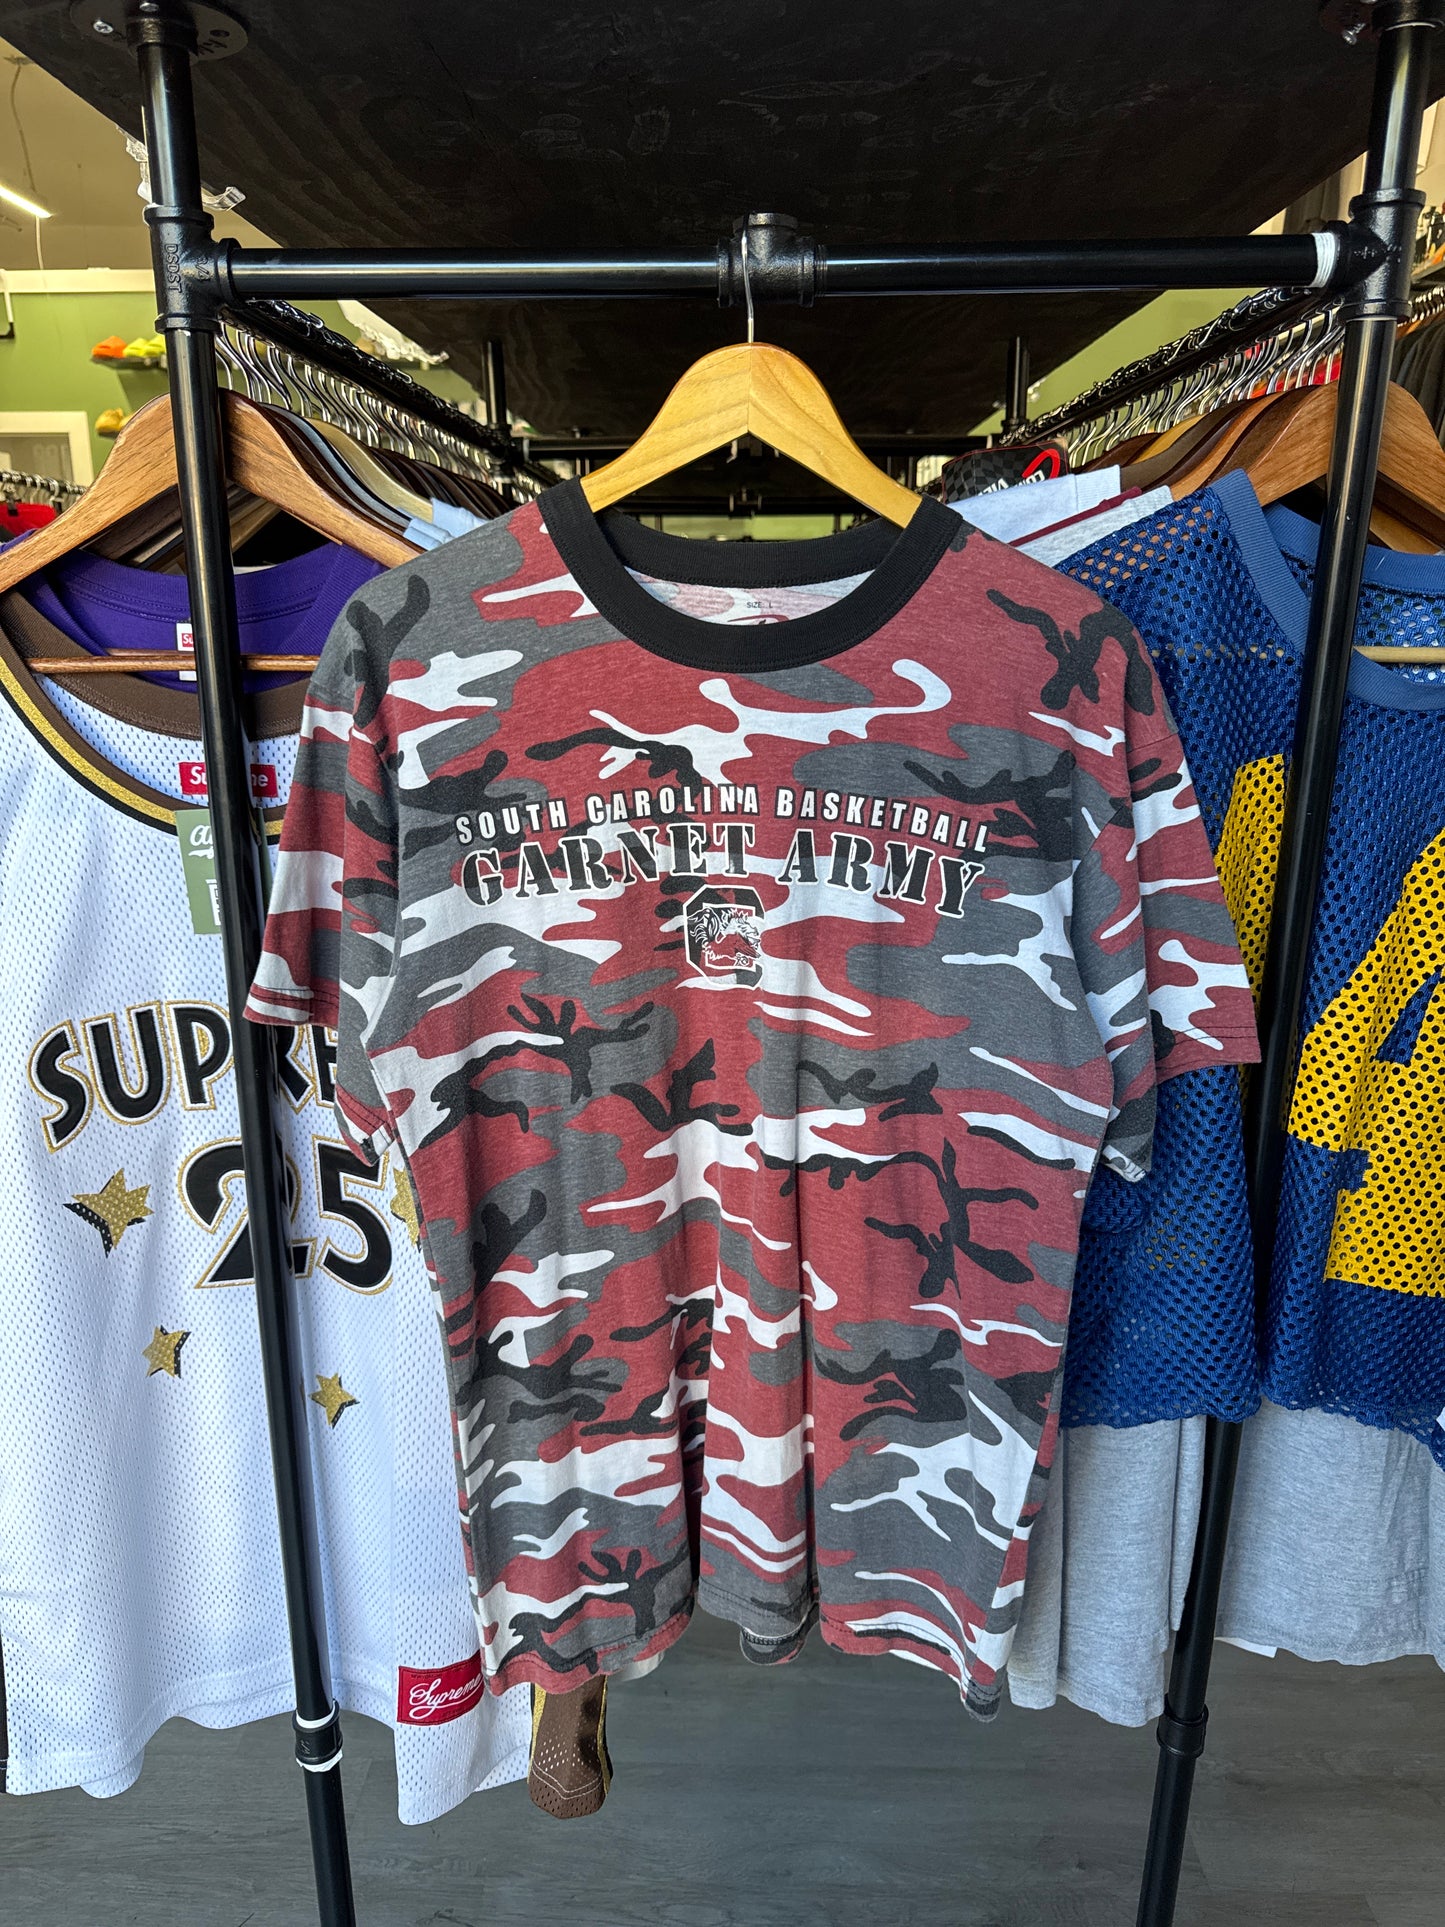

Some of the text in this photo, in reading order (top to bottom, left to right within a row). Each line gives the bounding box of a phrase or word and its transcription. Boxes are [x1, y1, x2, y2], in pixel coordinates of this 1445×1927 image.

[454, 782, 990, 854] SOUTH CAROLINA BASKETBALL
[460, 821, 985, 919] GARNET ARMY
[177, 1133, 394, 1296] 25
[408, 1673, 484, 1720] Supreme
